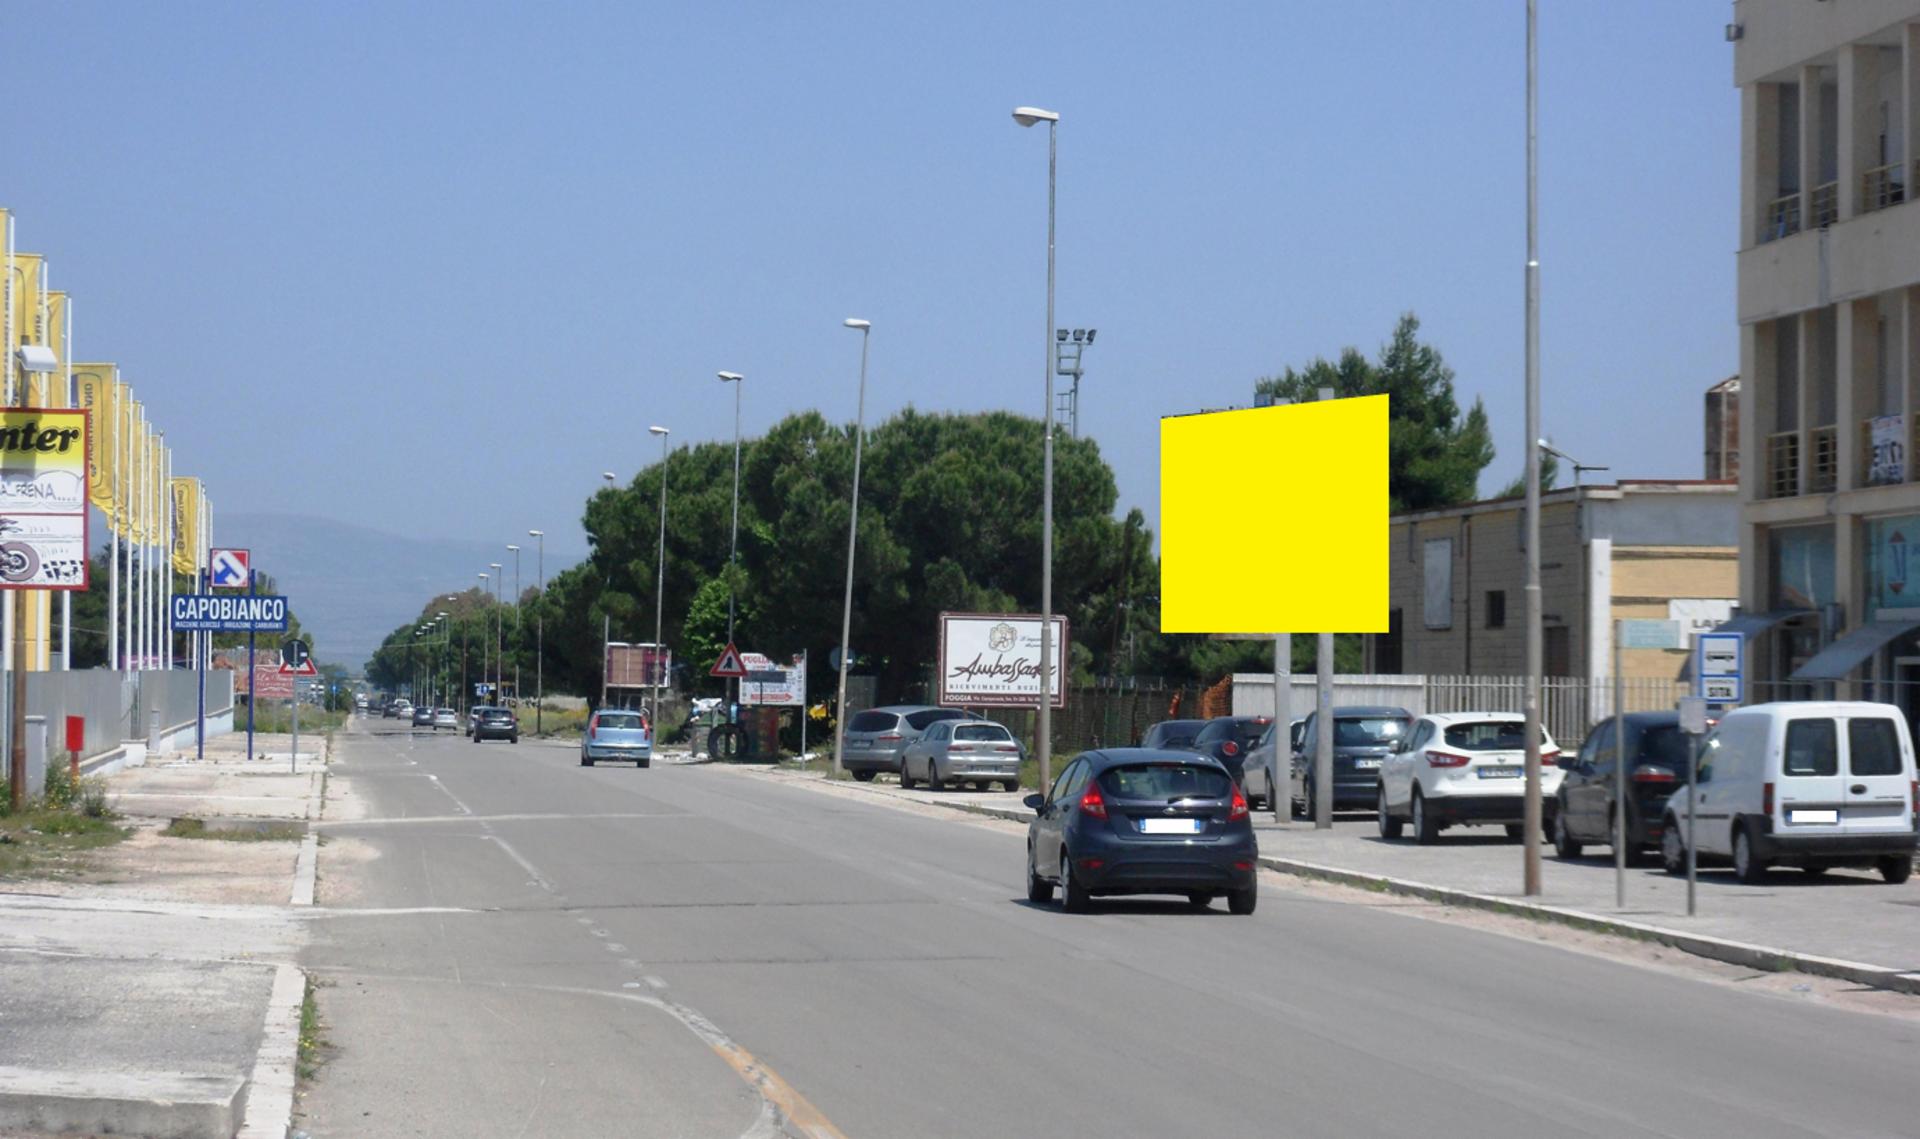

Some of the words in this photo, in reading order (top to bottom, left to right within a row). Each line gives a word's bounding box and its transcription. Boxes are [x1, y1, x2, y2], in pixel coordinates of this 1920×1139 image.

[0, 422, 80, 452] nter
[175, 597, 284, 621] CAPOBIANCO
[944, 694, 972, 702] FOGGIA
